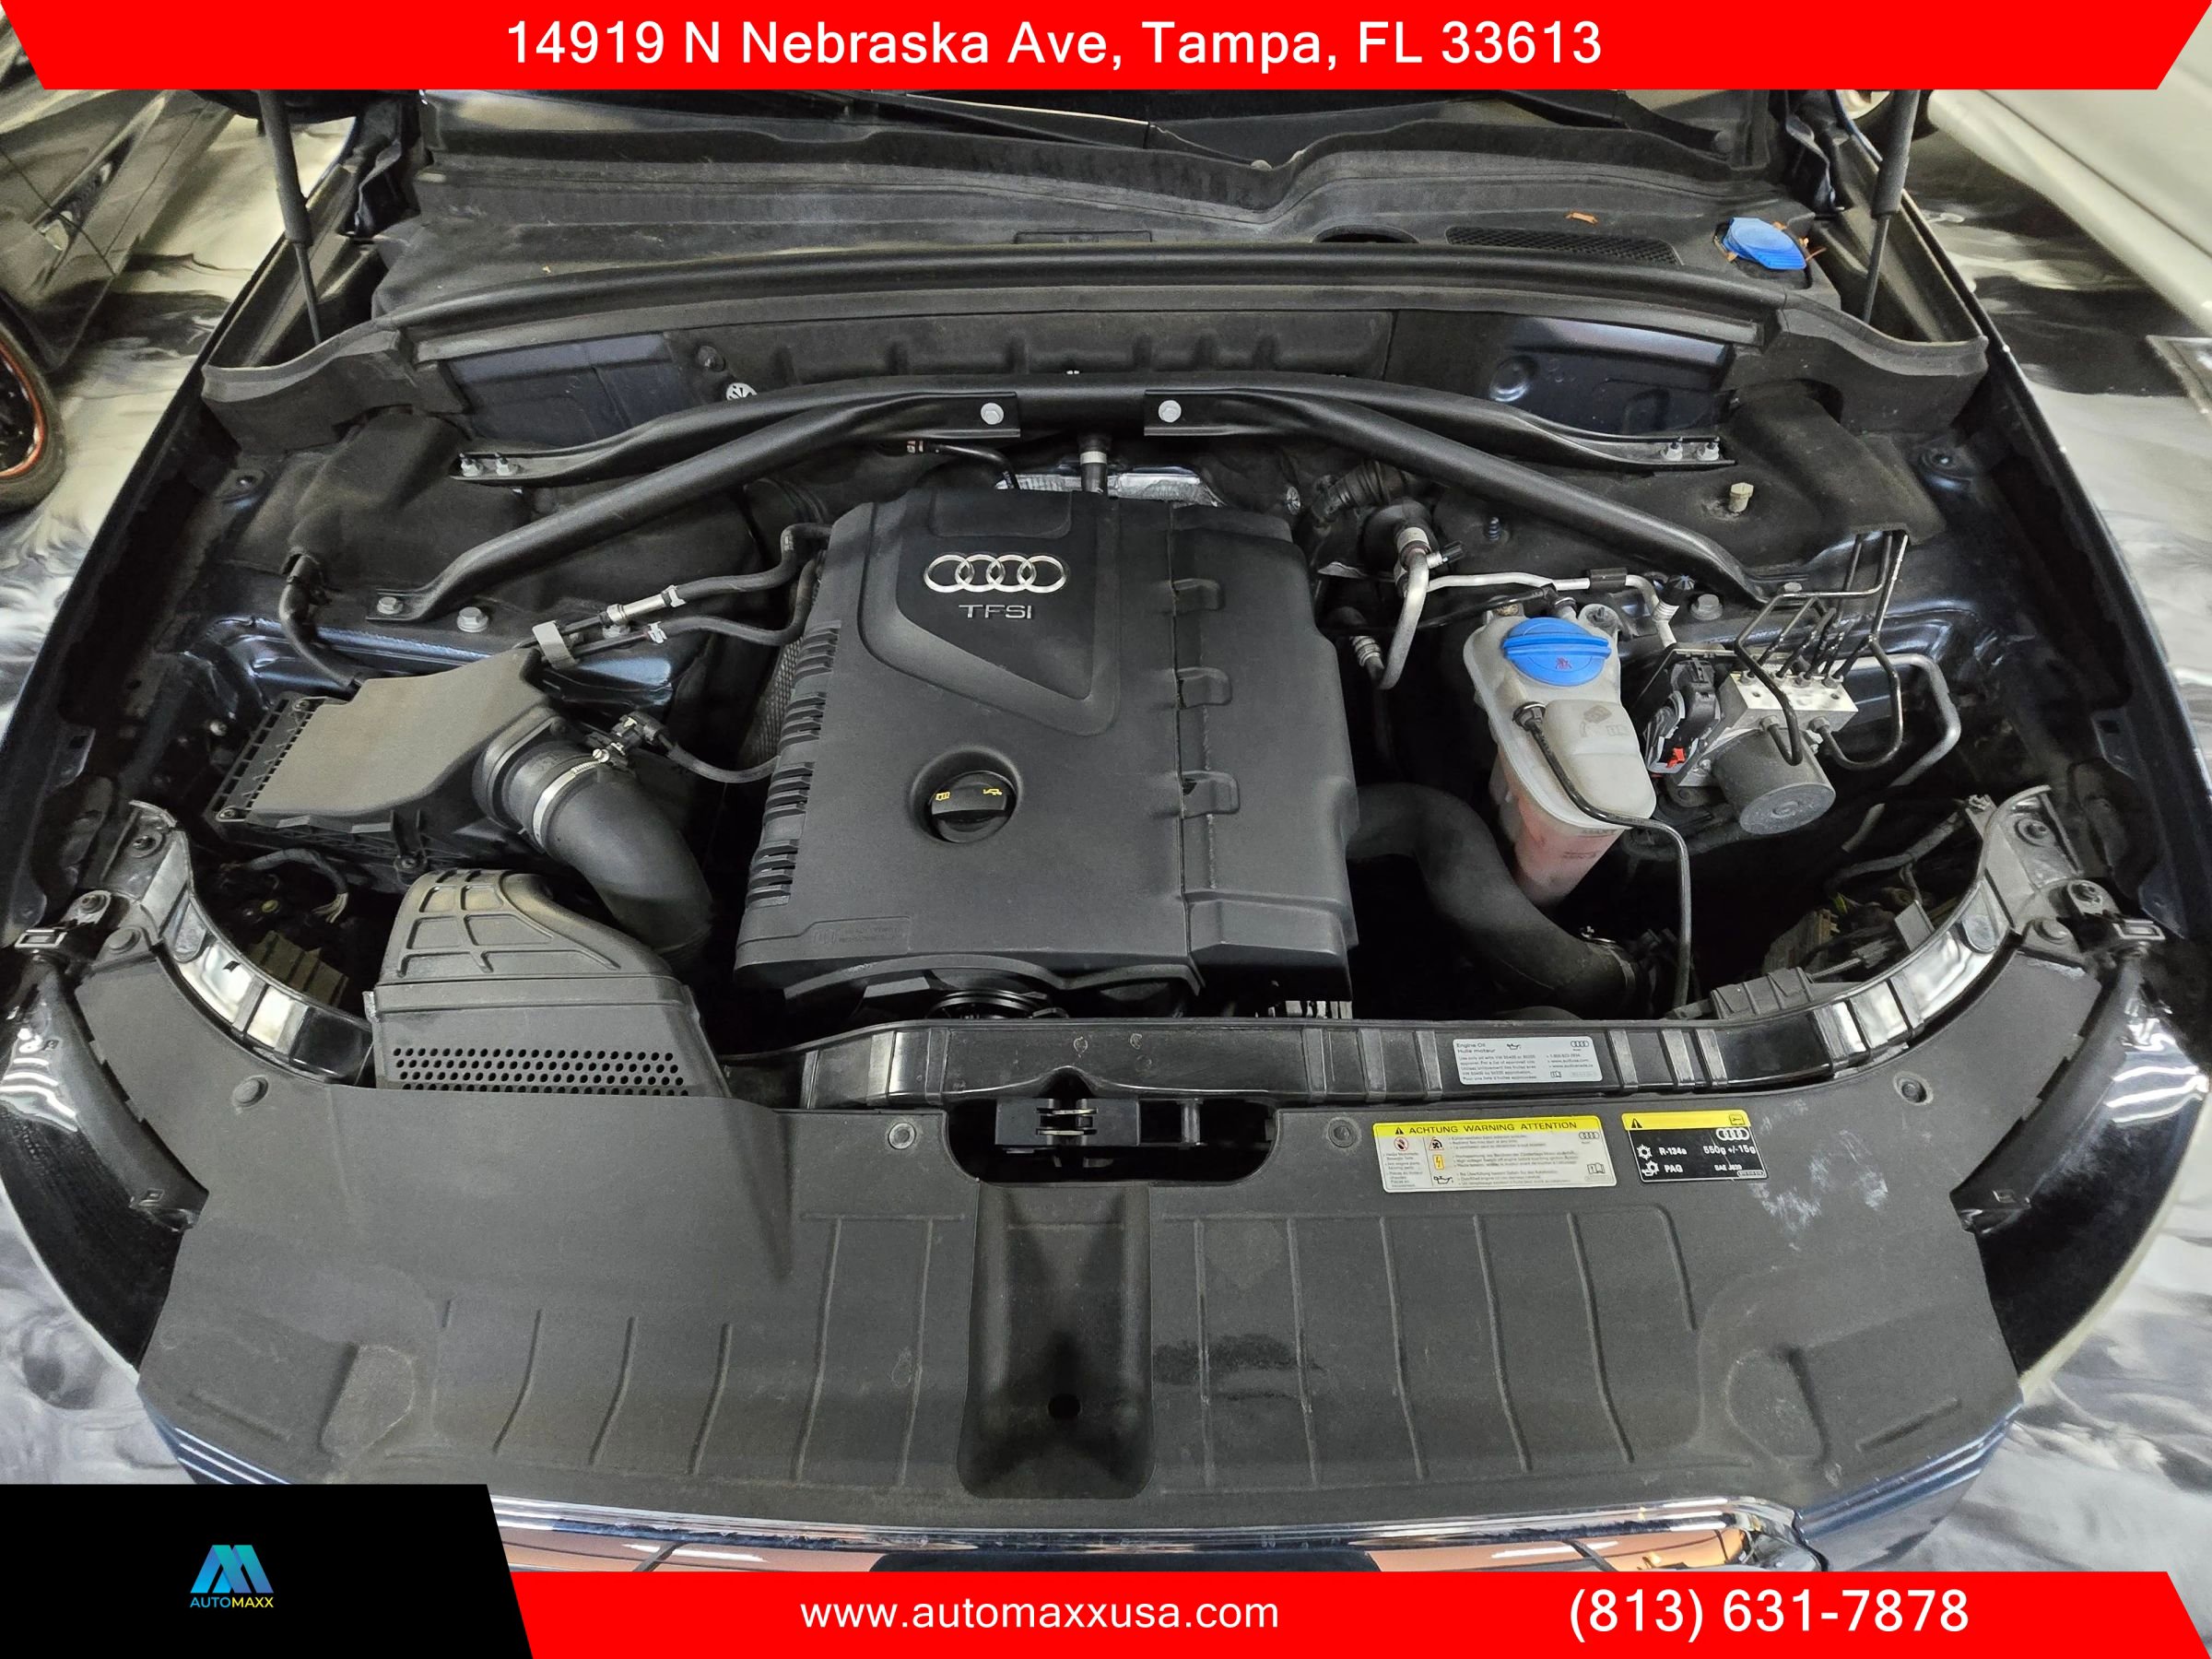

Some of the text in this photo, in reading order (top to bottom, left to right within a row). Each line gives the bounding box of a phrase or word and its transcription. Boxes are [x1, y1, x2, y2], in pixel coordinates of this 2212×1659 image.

[959, 604, 1031, 619] TFSI
[1409, 1121, 1577, 1135] ACHTUNG WARNING ATTENTION
[1659, 1147, 1688, 1156] R-134a
[1702, 1145, 1727, 1156] 550g
[1664, 1164, 1684, 1173] PAG
